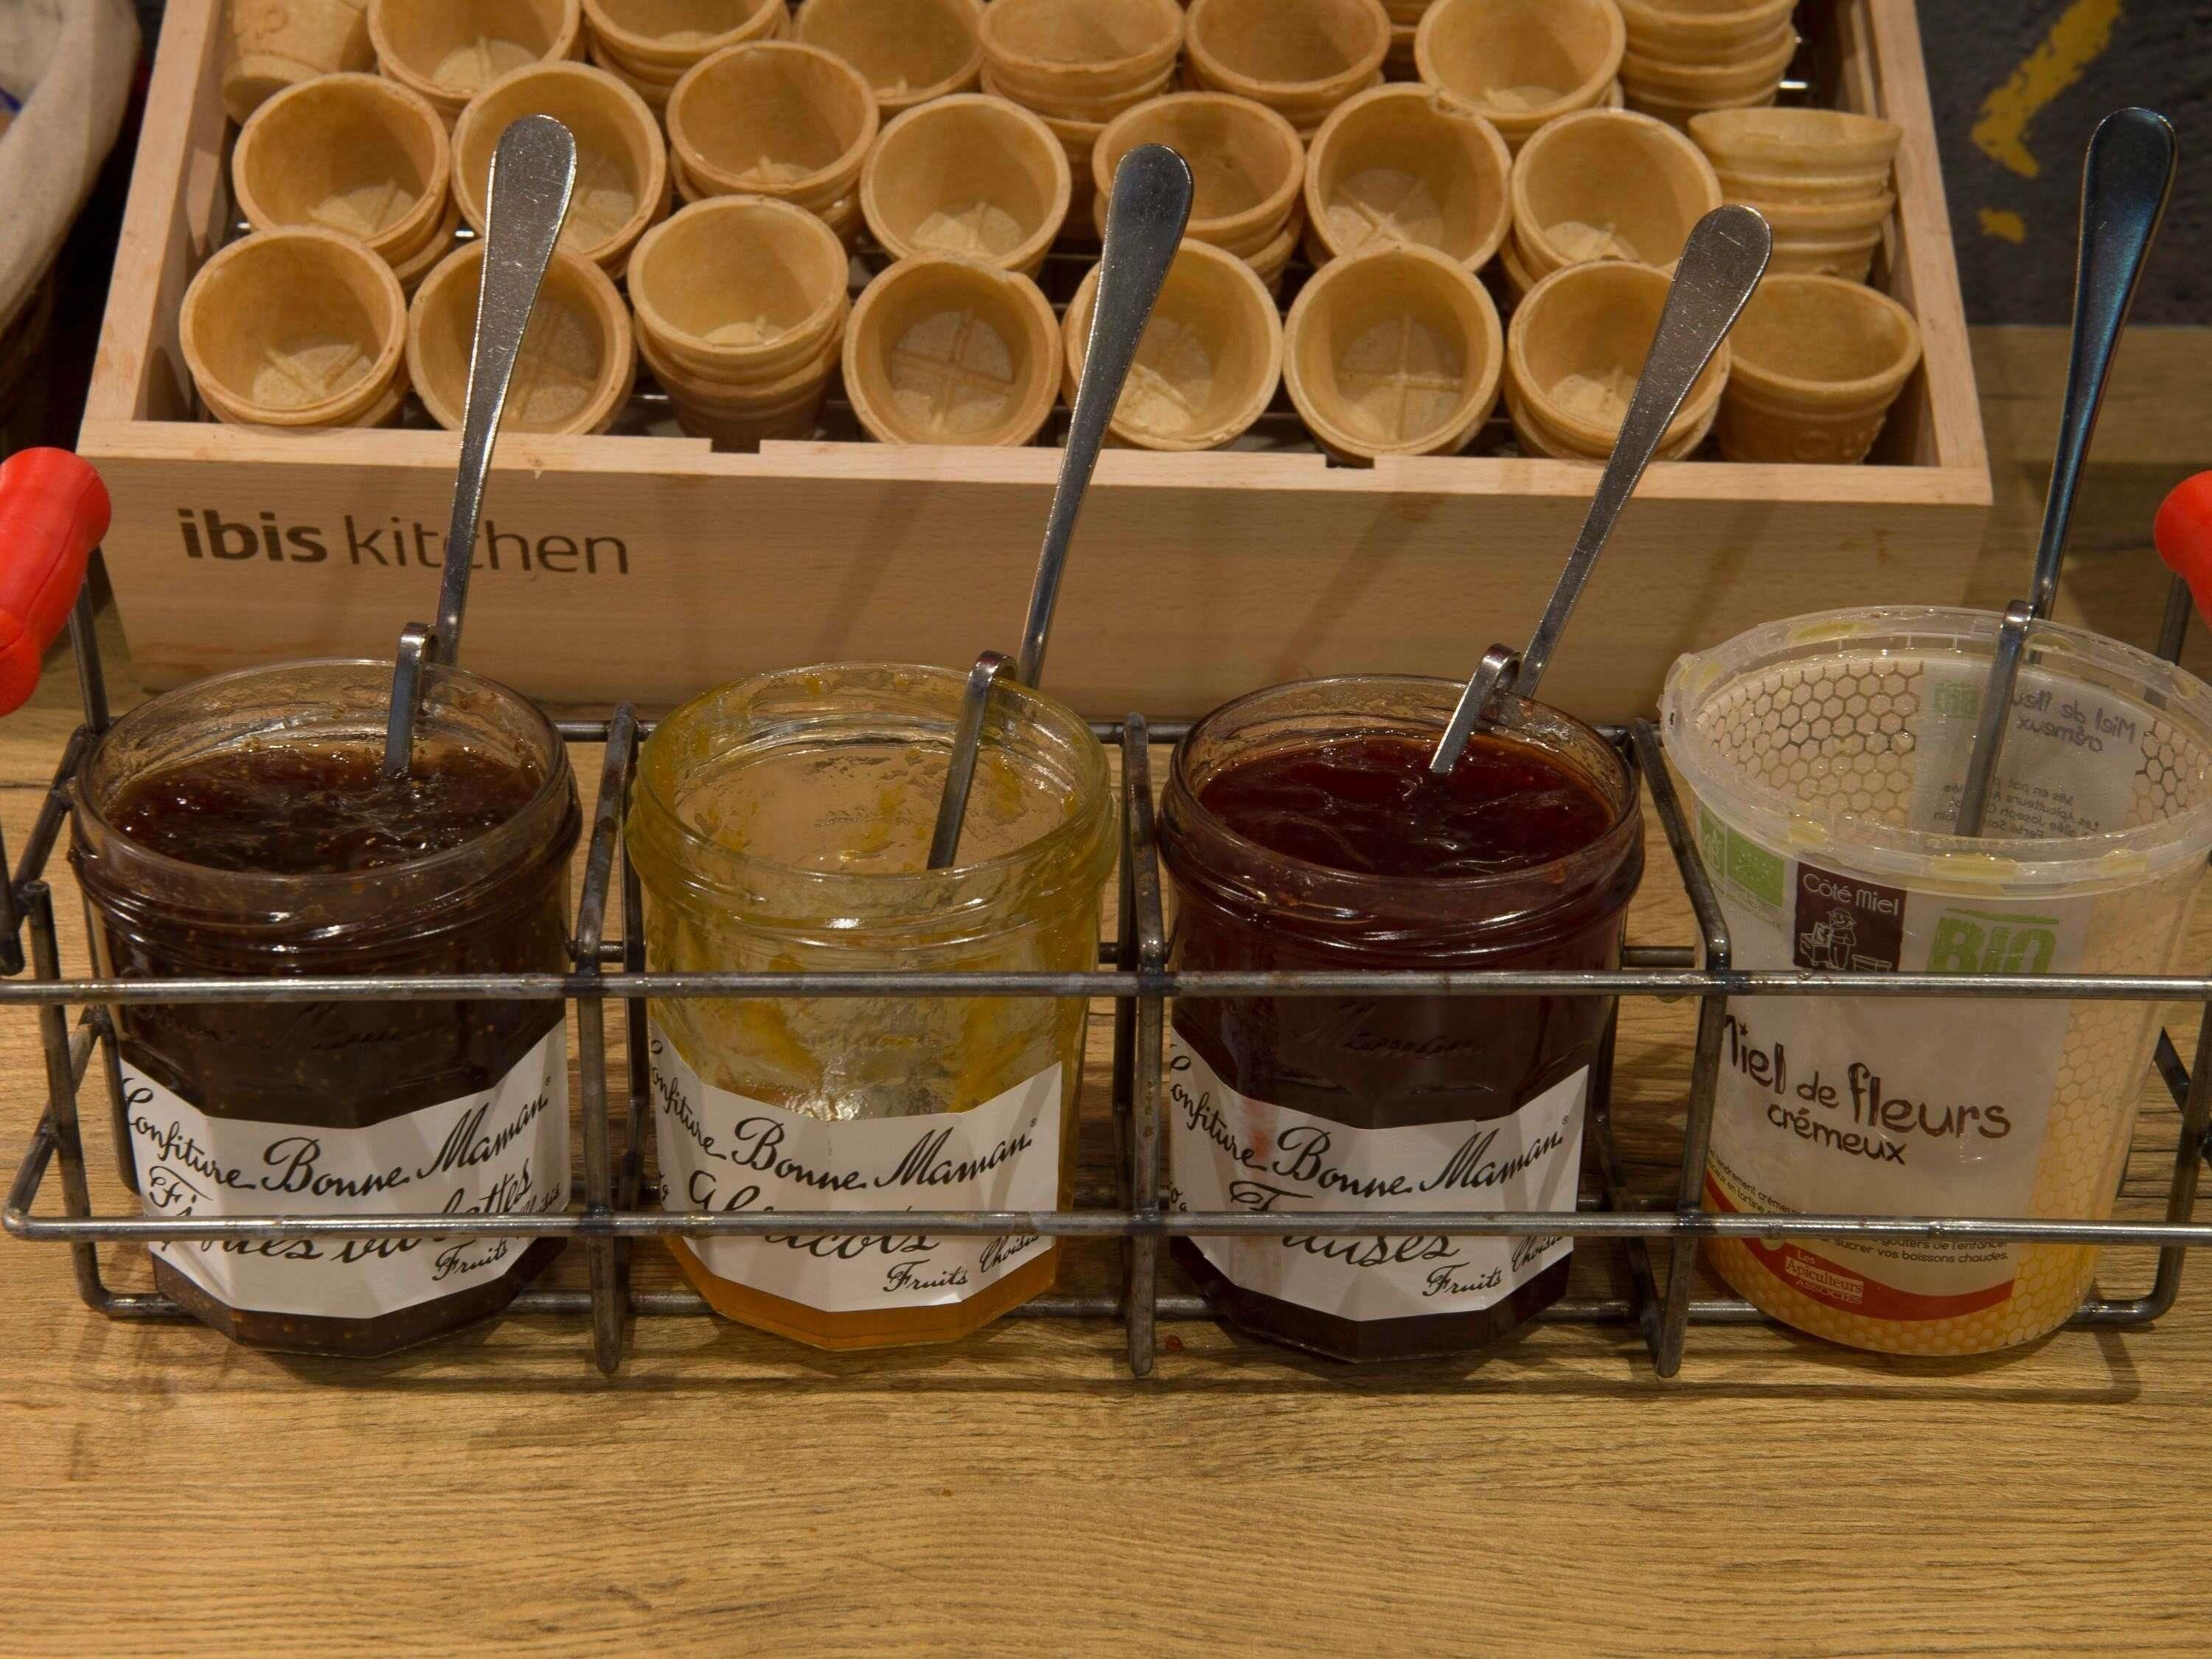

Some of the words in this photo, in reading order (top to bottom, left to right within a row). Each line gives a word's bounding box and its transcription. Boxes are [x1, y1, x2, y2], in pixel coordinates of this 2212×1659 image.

[177, 508, 327, 563] ibis
[1803, 873, 1853, 903] Côté
[650, 1038, 727, 1161] onfiture
[731, 1116, 869, 1191] Bonne
[1796, 1071, 1840, 1109] de
[1847, 1062, 2012, 1138] fleurs
[1273, 1126, 1413, 1197] Bonne
[1767, 1104, 1907, 1165] crémeux
[262, 1136, 411, 1197] Bonne
[432, 1239, 508, 1281] Fruits
[883, 1259, 969, 1293] Fruits
[1834, 1239, 1874, 1254] sucrer
[1877, 1248, 1900, 1259] vos
[1902, 1252, 1955, 1263] boissons
[1422, 1262, 1503, 1297] Fruits
